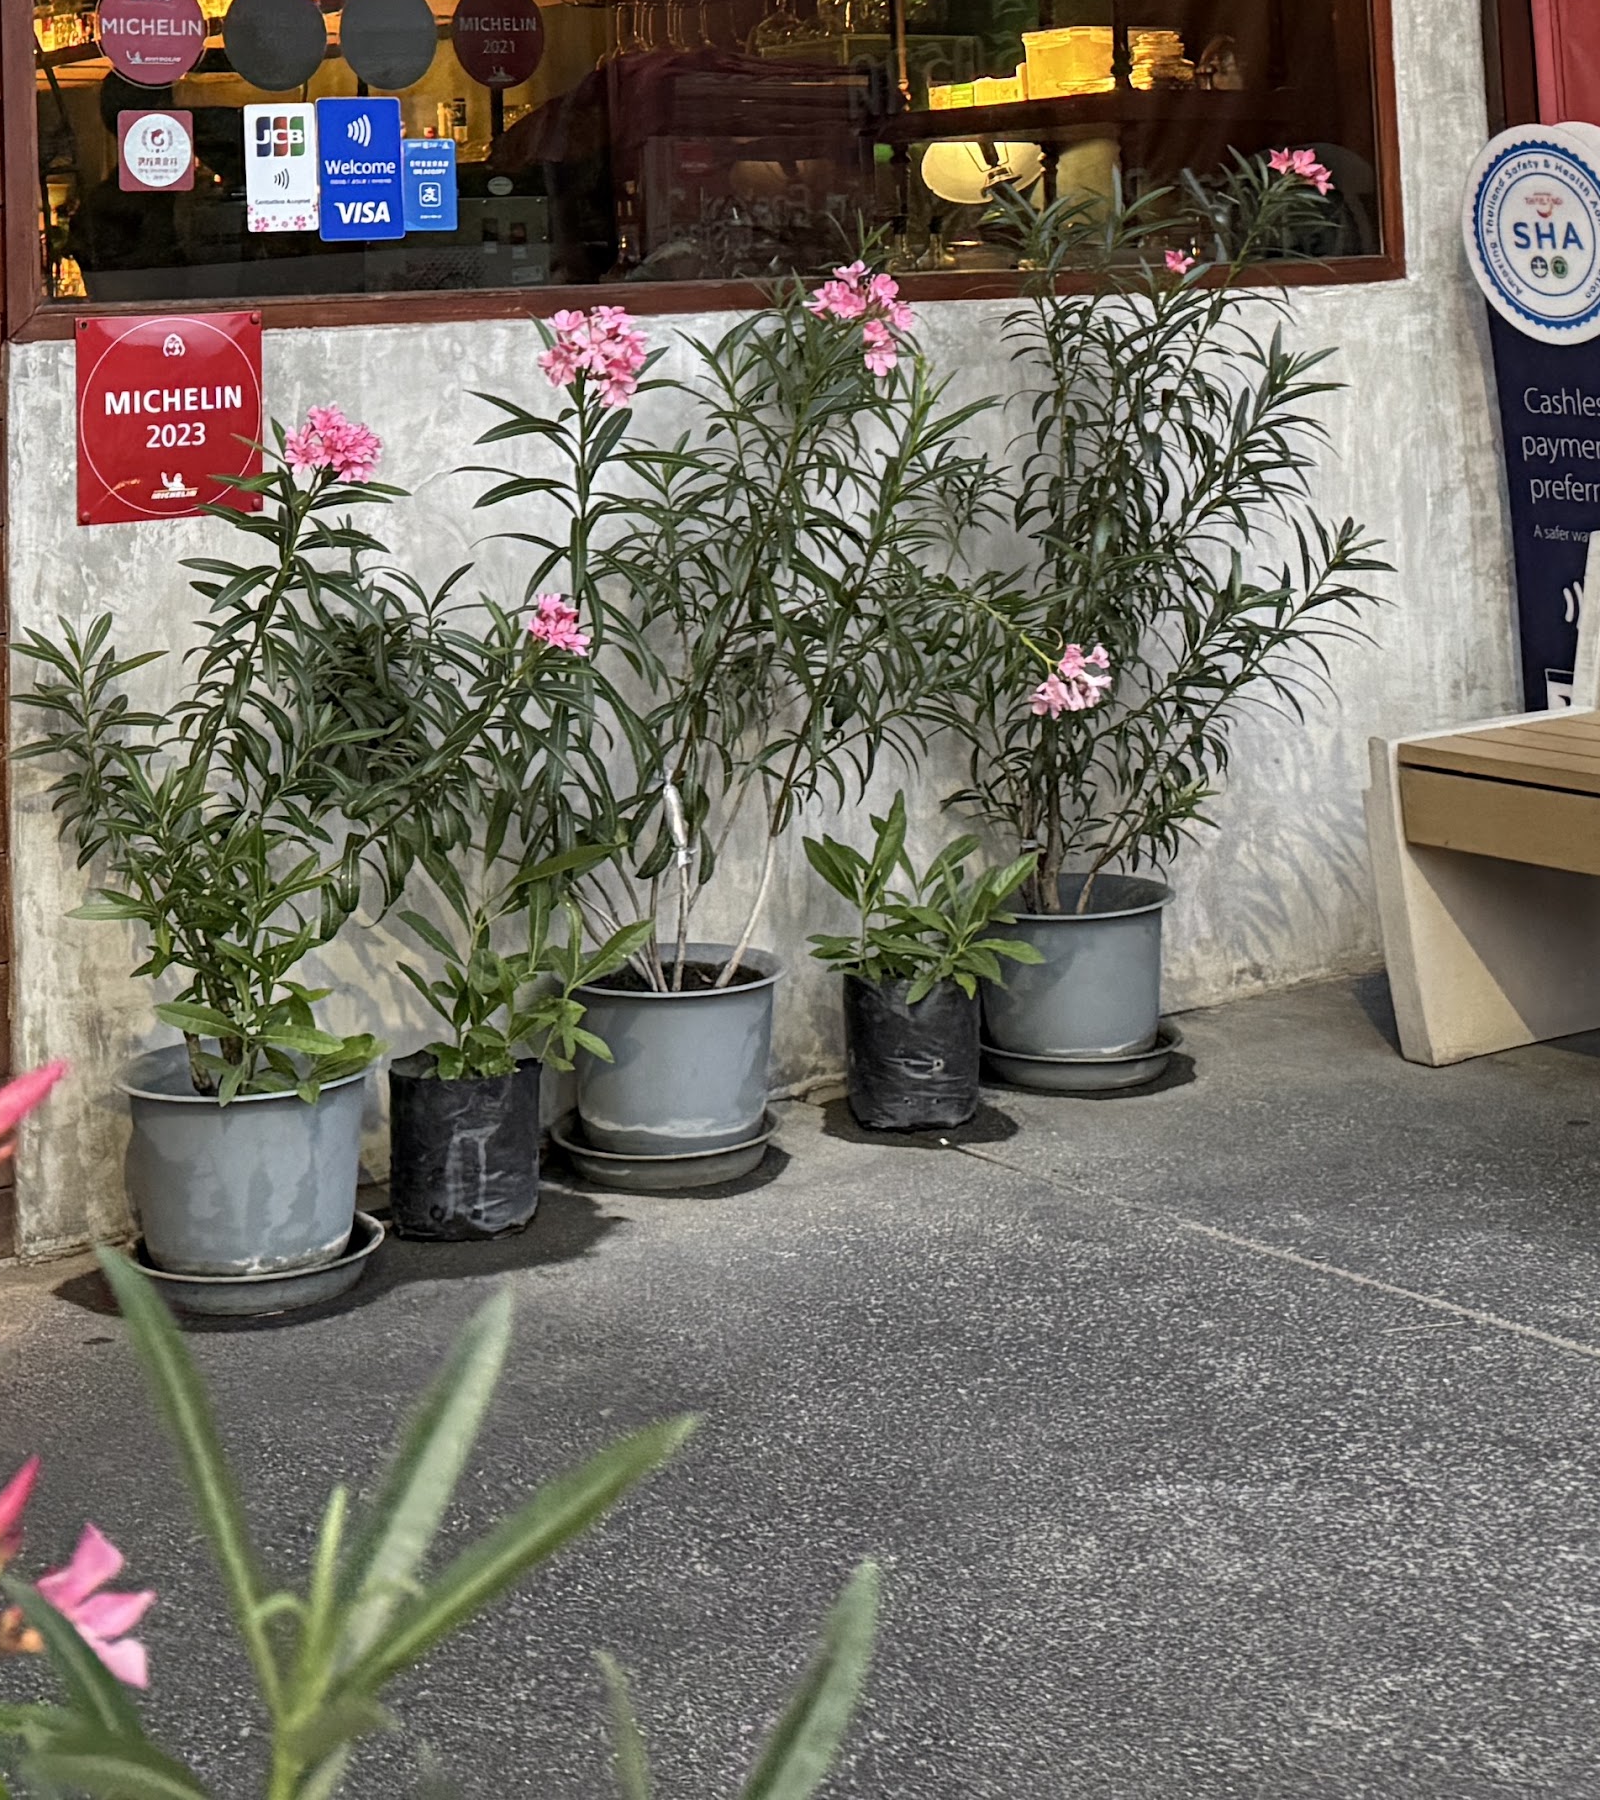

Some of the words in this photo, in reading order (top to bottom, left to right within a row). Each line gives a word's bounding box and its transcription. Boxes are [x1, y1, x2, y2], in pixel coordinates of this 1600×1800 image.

[101, 18, 203, 36] MICHELIN
[458, 16, 537, 31] MICHELIN
[483, 39, 516, 54] 2021
[324, 159, 396, 175] Welcome
[1504, 158, 1539, 180] Safety
[1543, 159, 1550, 168] &
[1555, 162, 1591, 197] Health
[334, 201, 391, 224] VISA
[1485, 178, 1506, 235] Thailand
[1513, 221, 1584, 250] SHA
[1488, 241, 1523, 296] Amazing
[104, 384, 243, 416] MICHELIN
[146, 422, 206, 448] 2023
[150, 488, 198, 500] MICHELIN
[1533, 525, 1543, 539] A
[1544, 524, 1570, 541] safer
[1572, 531, 1591, 544] wa
